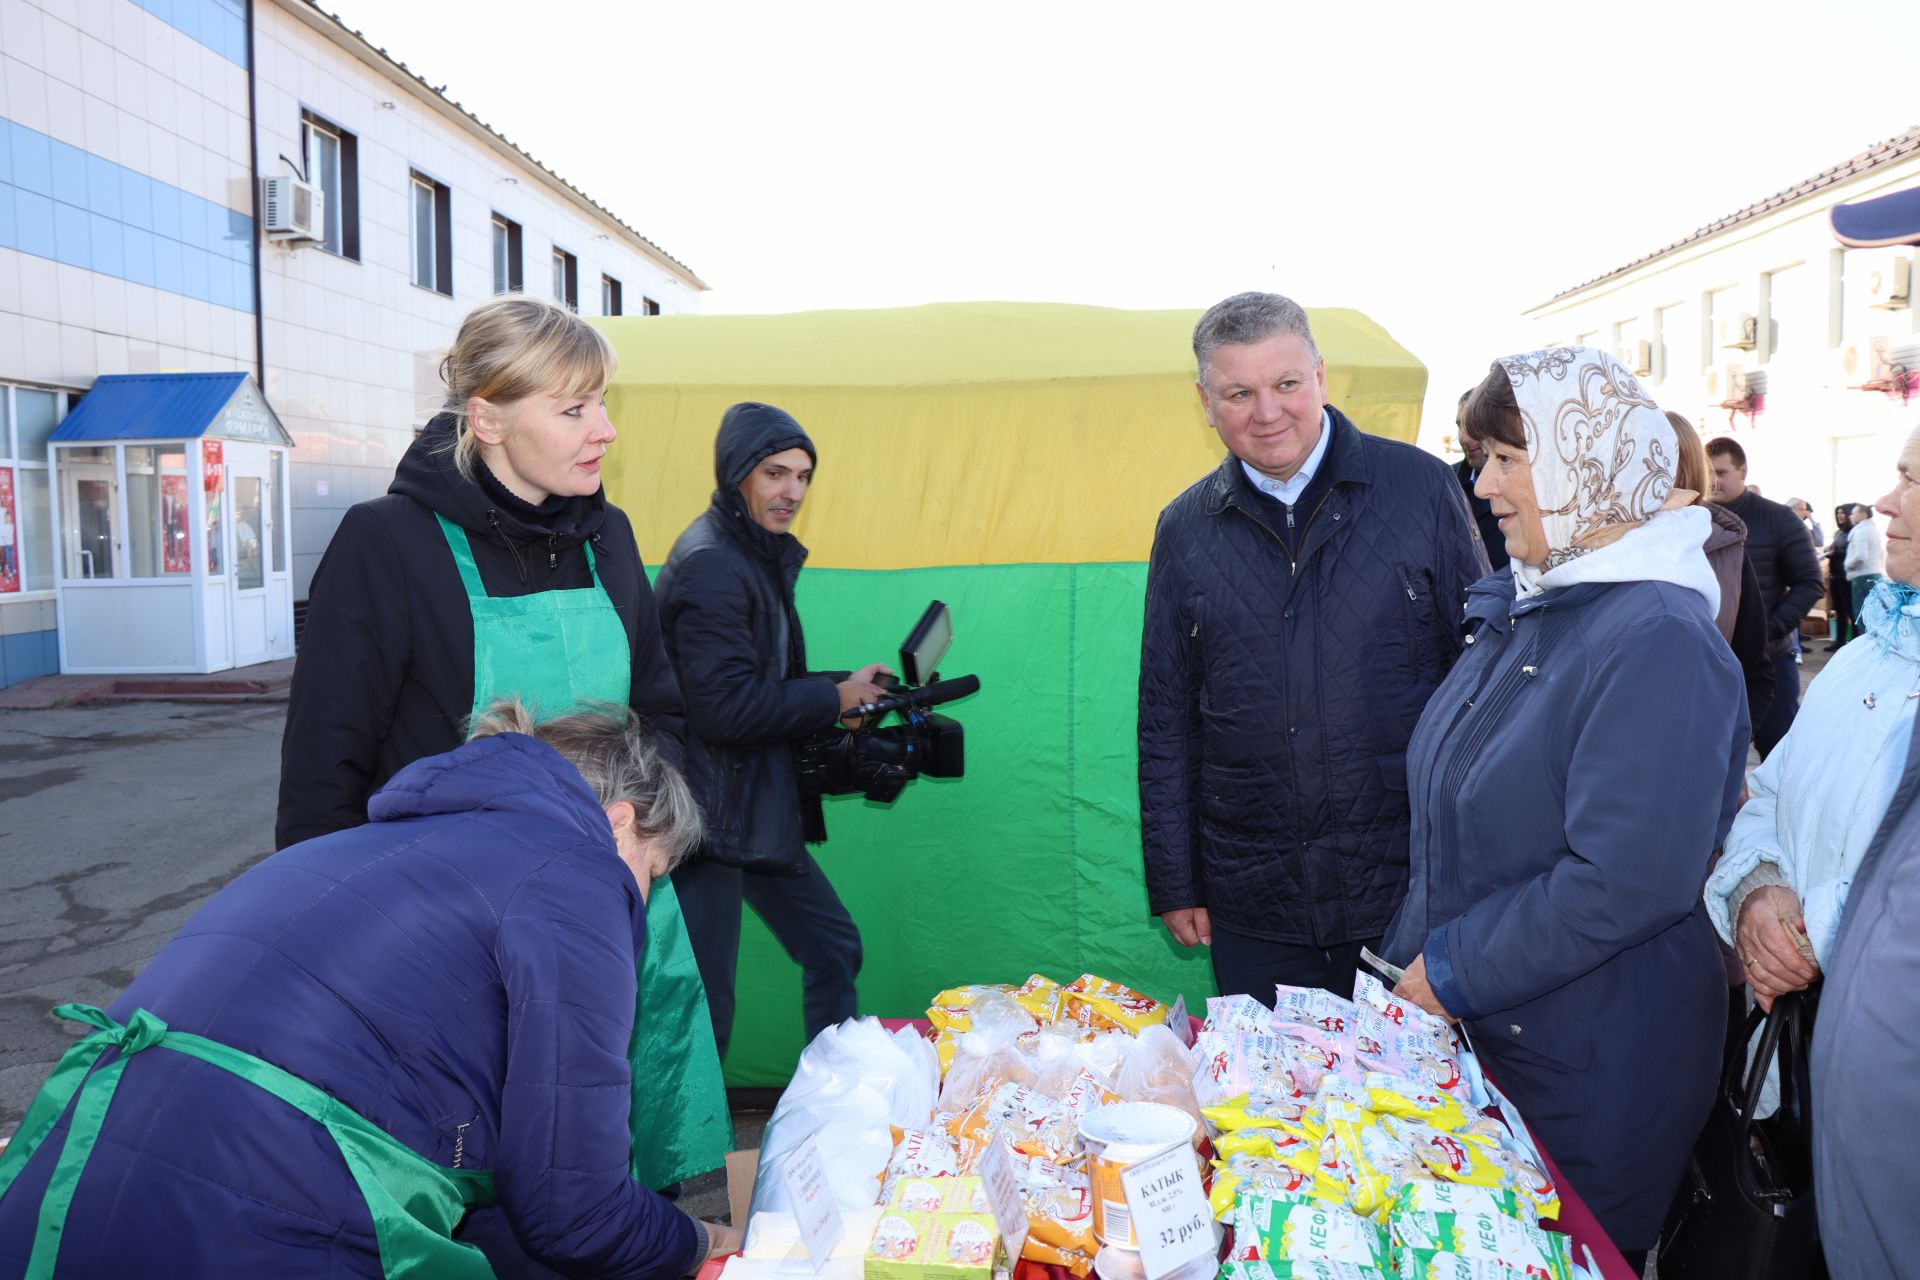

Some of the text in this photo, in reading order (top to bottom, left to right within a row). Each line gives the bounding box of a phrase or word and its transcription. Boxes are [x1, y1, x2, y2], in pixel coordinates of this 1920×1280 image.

[1141, 1168, 1184, 1199] КАТЫК
[1159, 1213, 1206, 1249] 32 руб.
